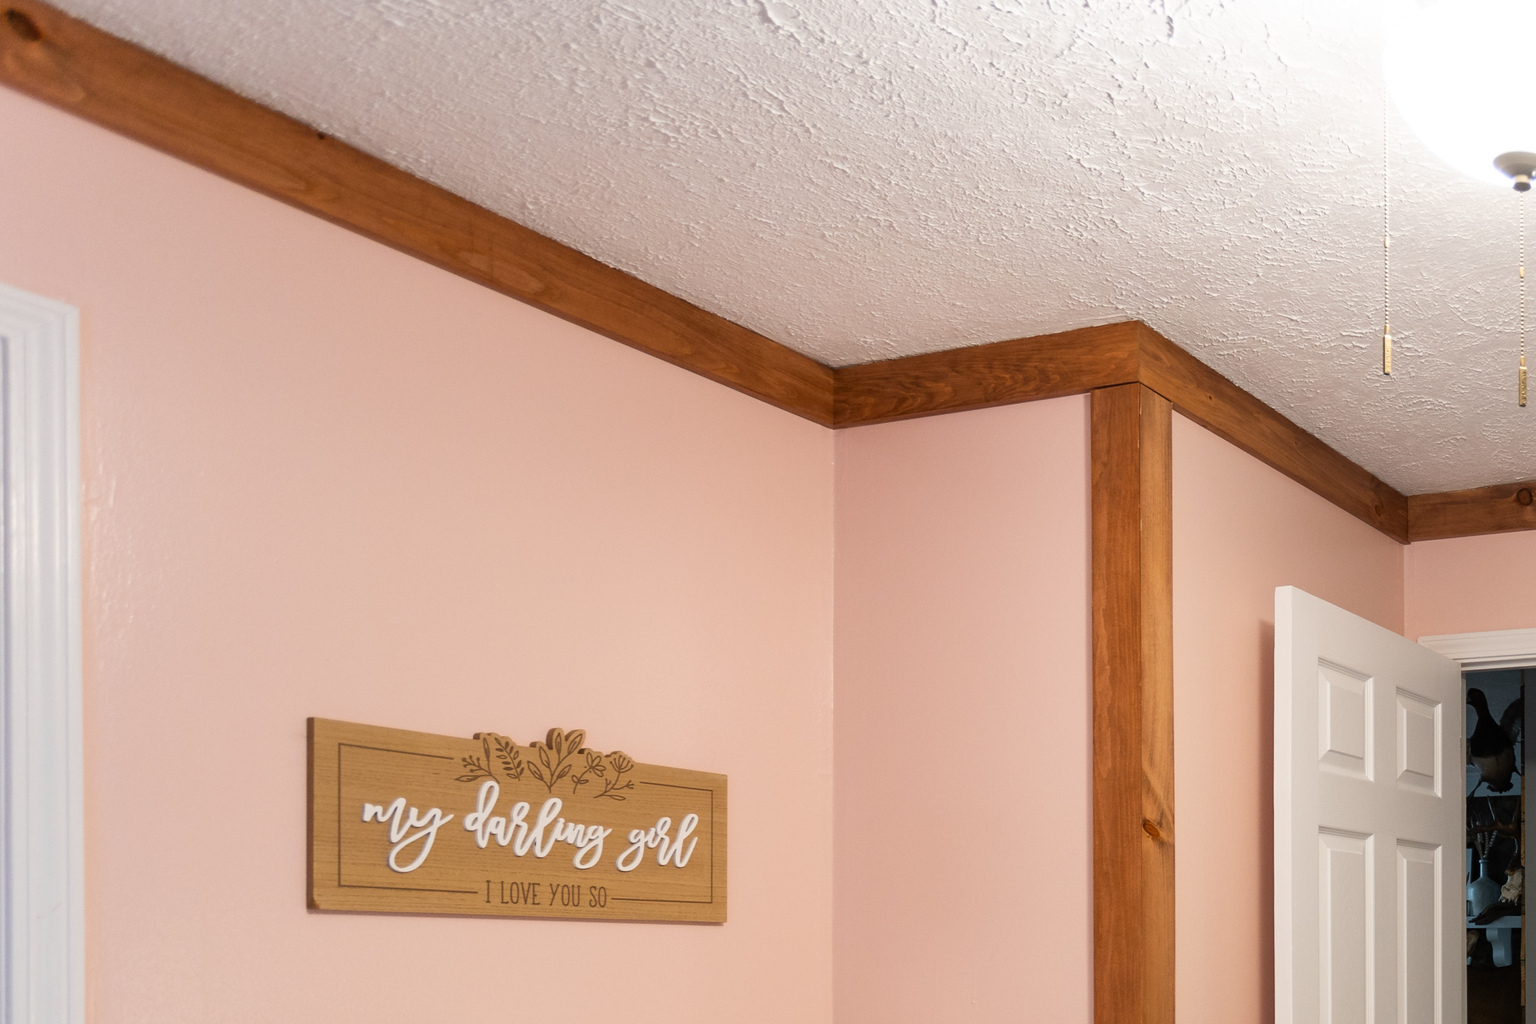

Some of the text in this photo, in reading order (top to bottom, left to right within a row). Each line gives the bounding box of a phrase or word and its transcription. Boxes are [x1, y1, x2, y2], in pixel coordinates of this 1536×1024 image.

[362, 781, 699, 873] my darling girl
[485, 880, 607, 909] I LOVE YOU SO
